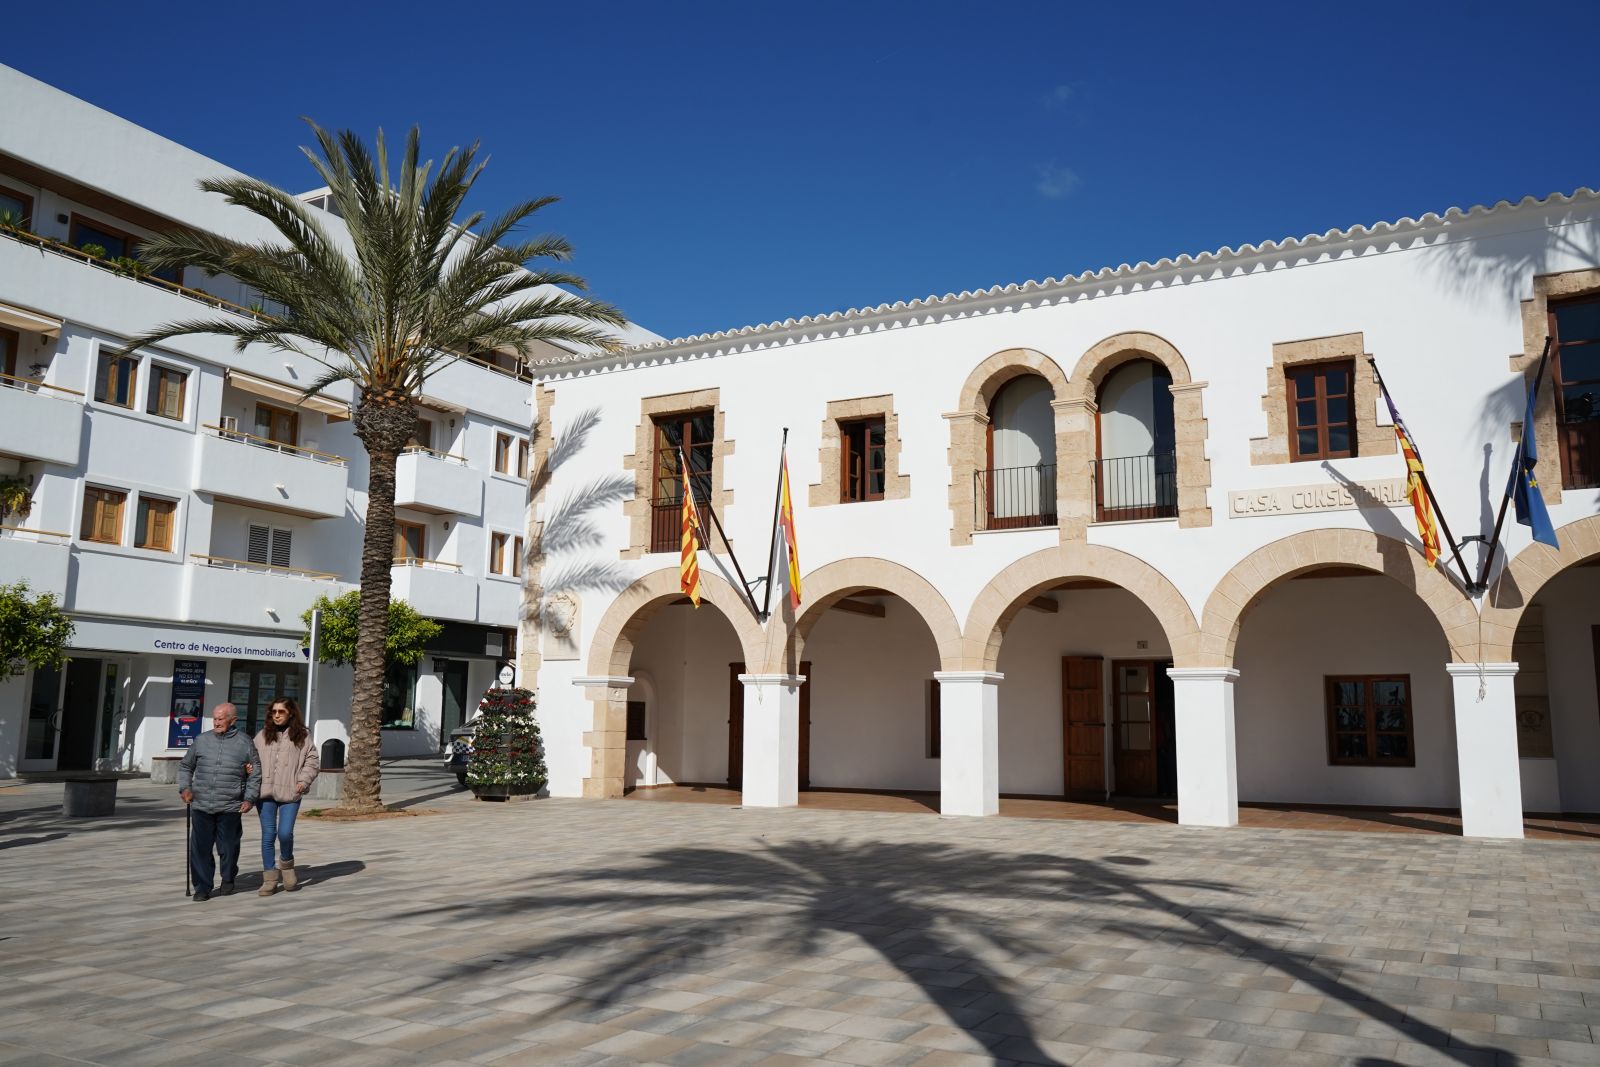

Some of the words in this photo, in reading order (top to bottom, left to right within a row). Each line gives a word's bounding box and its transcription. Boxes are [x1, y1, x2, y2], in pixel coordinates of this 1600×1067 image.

[1233, 494, 1281, 513] CASA
[1291, 484, 1408, 510] CONSISTORIA
[154, 639, 186, 651] Centro
[187, 642, 200, 651] de
[202, 643, 242, 655] Negocios
[244, 646, 296, 658] Inmobiliarios
